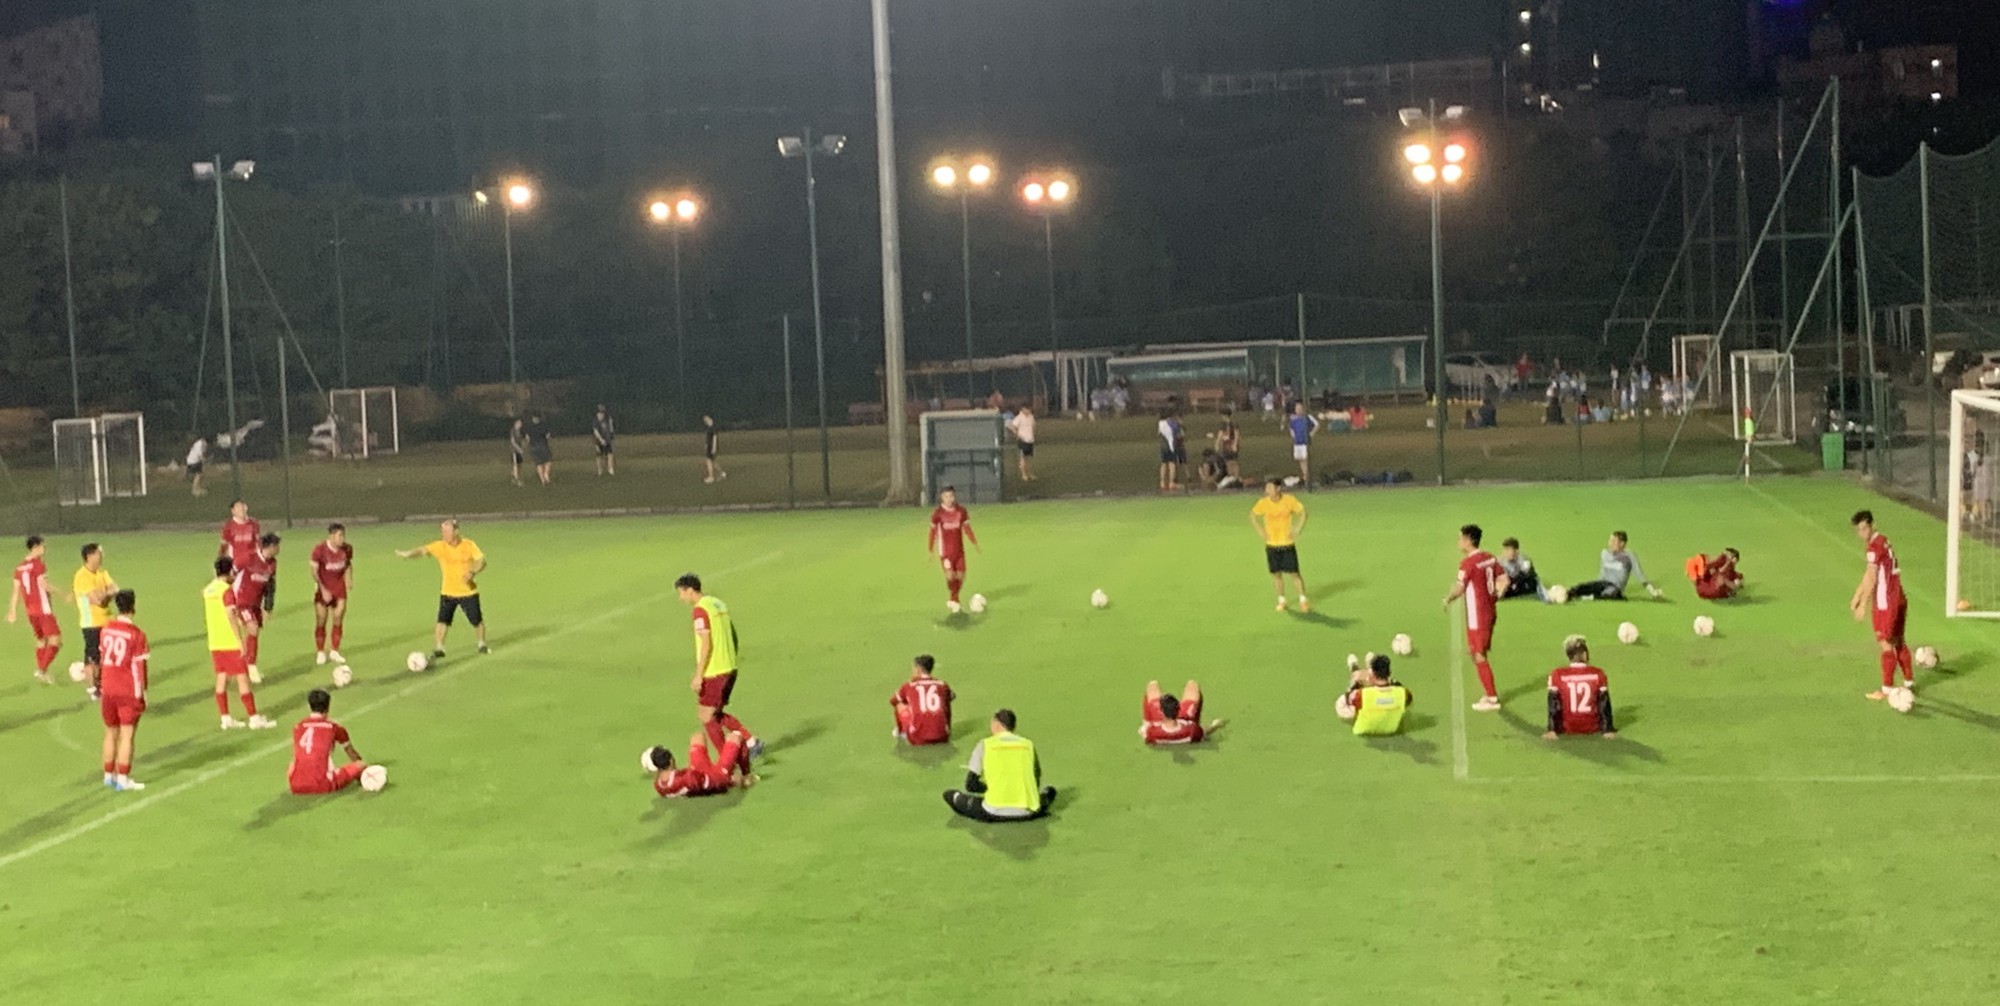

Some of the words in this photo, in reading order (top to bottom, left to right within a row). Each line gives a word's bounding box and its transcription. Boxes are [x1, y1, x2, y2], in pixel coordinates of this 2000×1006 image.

[103, 635, 127, 667] 29
[915, 684, 941, 713] 16
[1567, 681, 1592, 713] 12
[299, 727, 314, 754] 4
